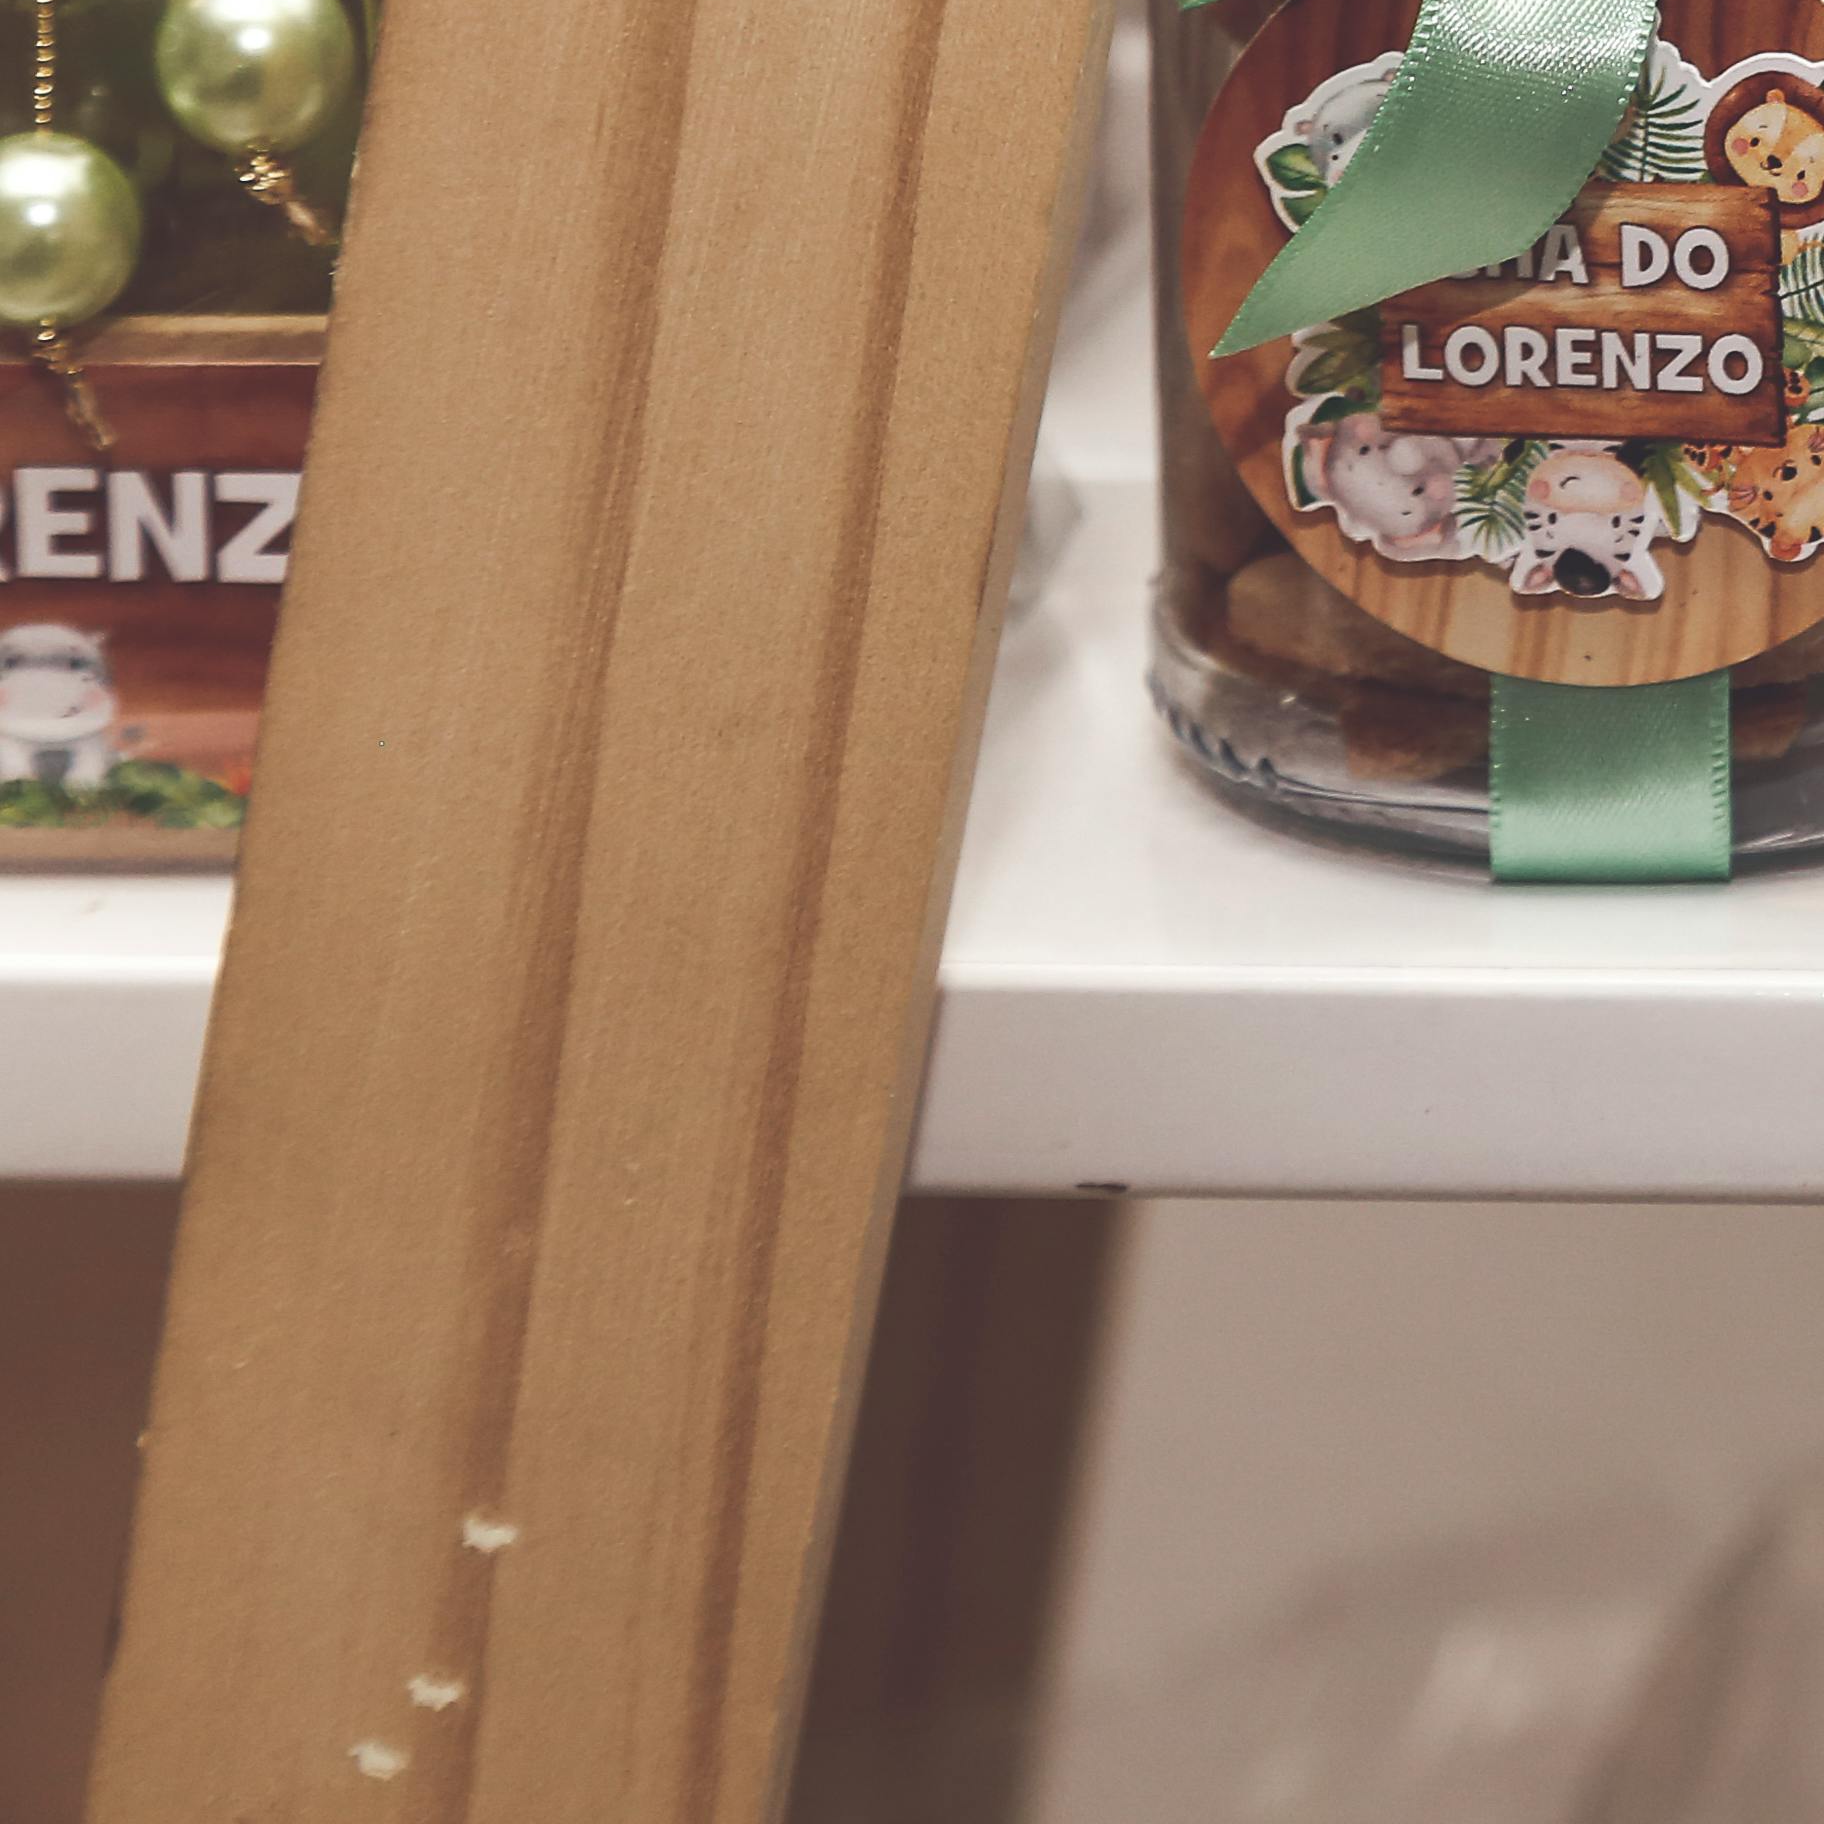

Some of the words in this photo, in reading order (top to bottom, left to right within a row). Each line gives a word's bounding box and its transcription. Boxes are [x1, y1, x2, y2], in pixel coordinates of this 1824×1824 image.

[1620, 223, 1730, 291] DO
[1401, 323, 1764, 396] LORENZO
[0, 467, 303, 584] ENZ
